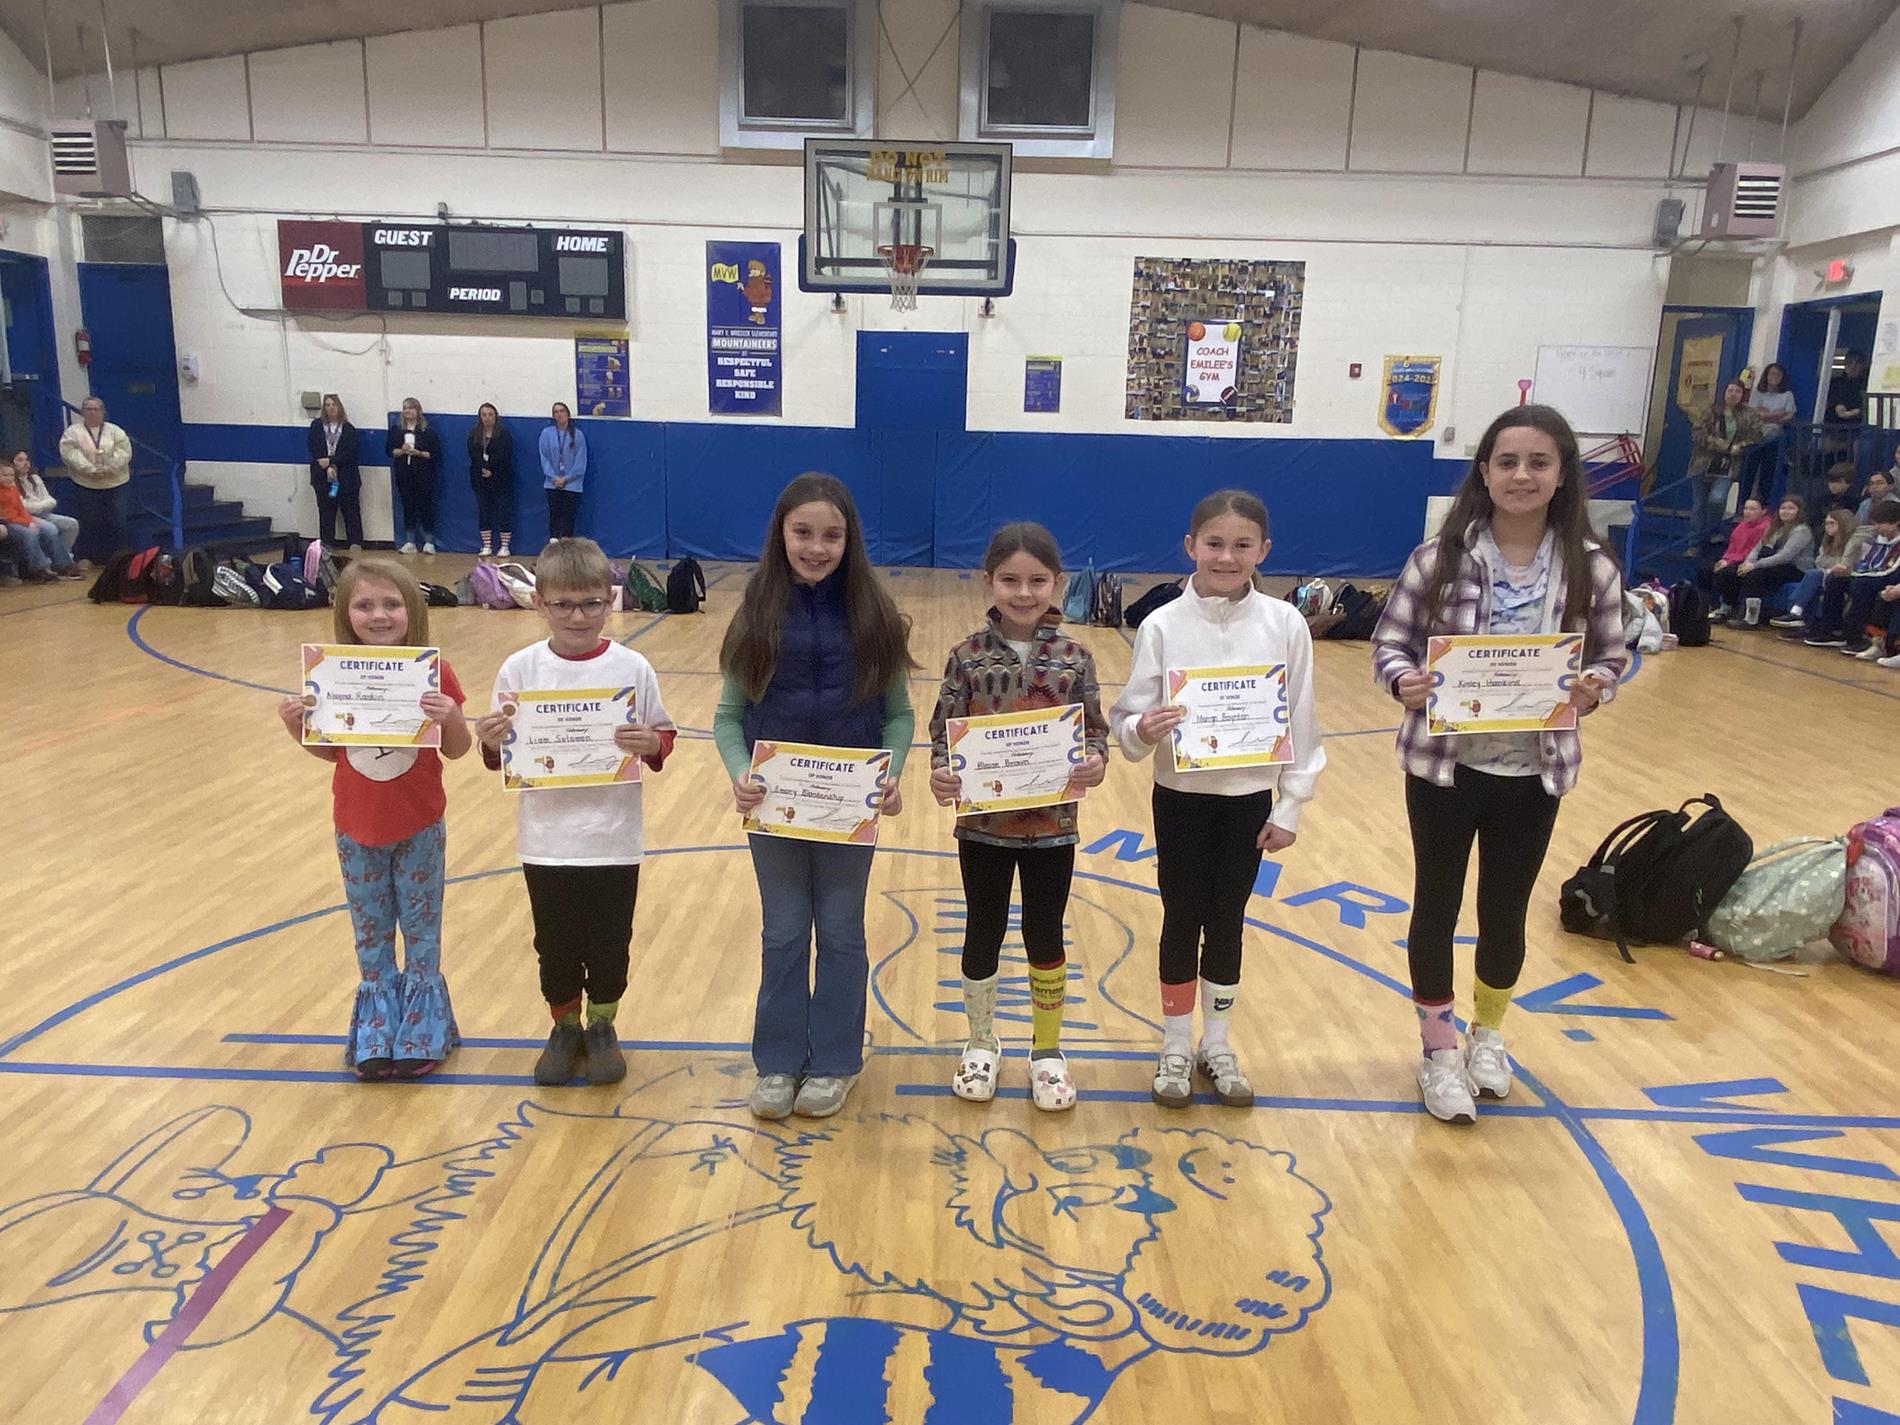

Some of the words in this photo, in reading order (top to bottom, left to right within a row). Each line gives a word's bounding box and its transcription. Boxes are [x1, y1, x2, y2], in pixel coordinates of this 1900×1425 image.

[374, 229, 432, 247] GUEST
[556, 235, 608, 252] HOME
[309, 243, 339, 263] Dr
[284, 249, 361, 283] Pepper
[713, 267, 737, 281] MVW
[449, 287, 501, 302] PERIOD
[712, 338, 778, 350] MOUNTAINEERS
[1196, 347, 1229, 357] COACH
[717, 357, 772, 367] RESPECTFUL
[1190, 359, 1233, 370] EMILEE'S
[734, 368, 756, 378] SAFE
[1199, 372, 1220, 382] GYM
[715, 379, 774, 389] RESPONSIBLE
[734, 390, 756, 399] KIND
[1468, 648, 1541, 659] CERTIFICATE
[340, 660, 404, 672] CERTIFICATE
[1201, 679, 1256, 692] CERTIFICATE
[536, 702, 601, 714] CERTIFICATE
[985, 724, 1049, 740] CERTIFICATE
[790, 757, 856, 773] CERTIFICATE
[1511, 972, 1677, 1042] V.
